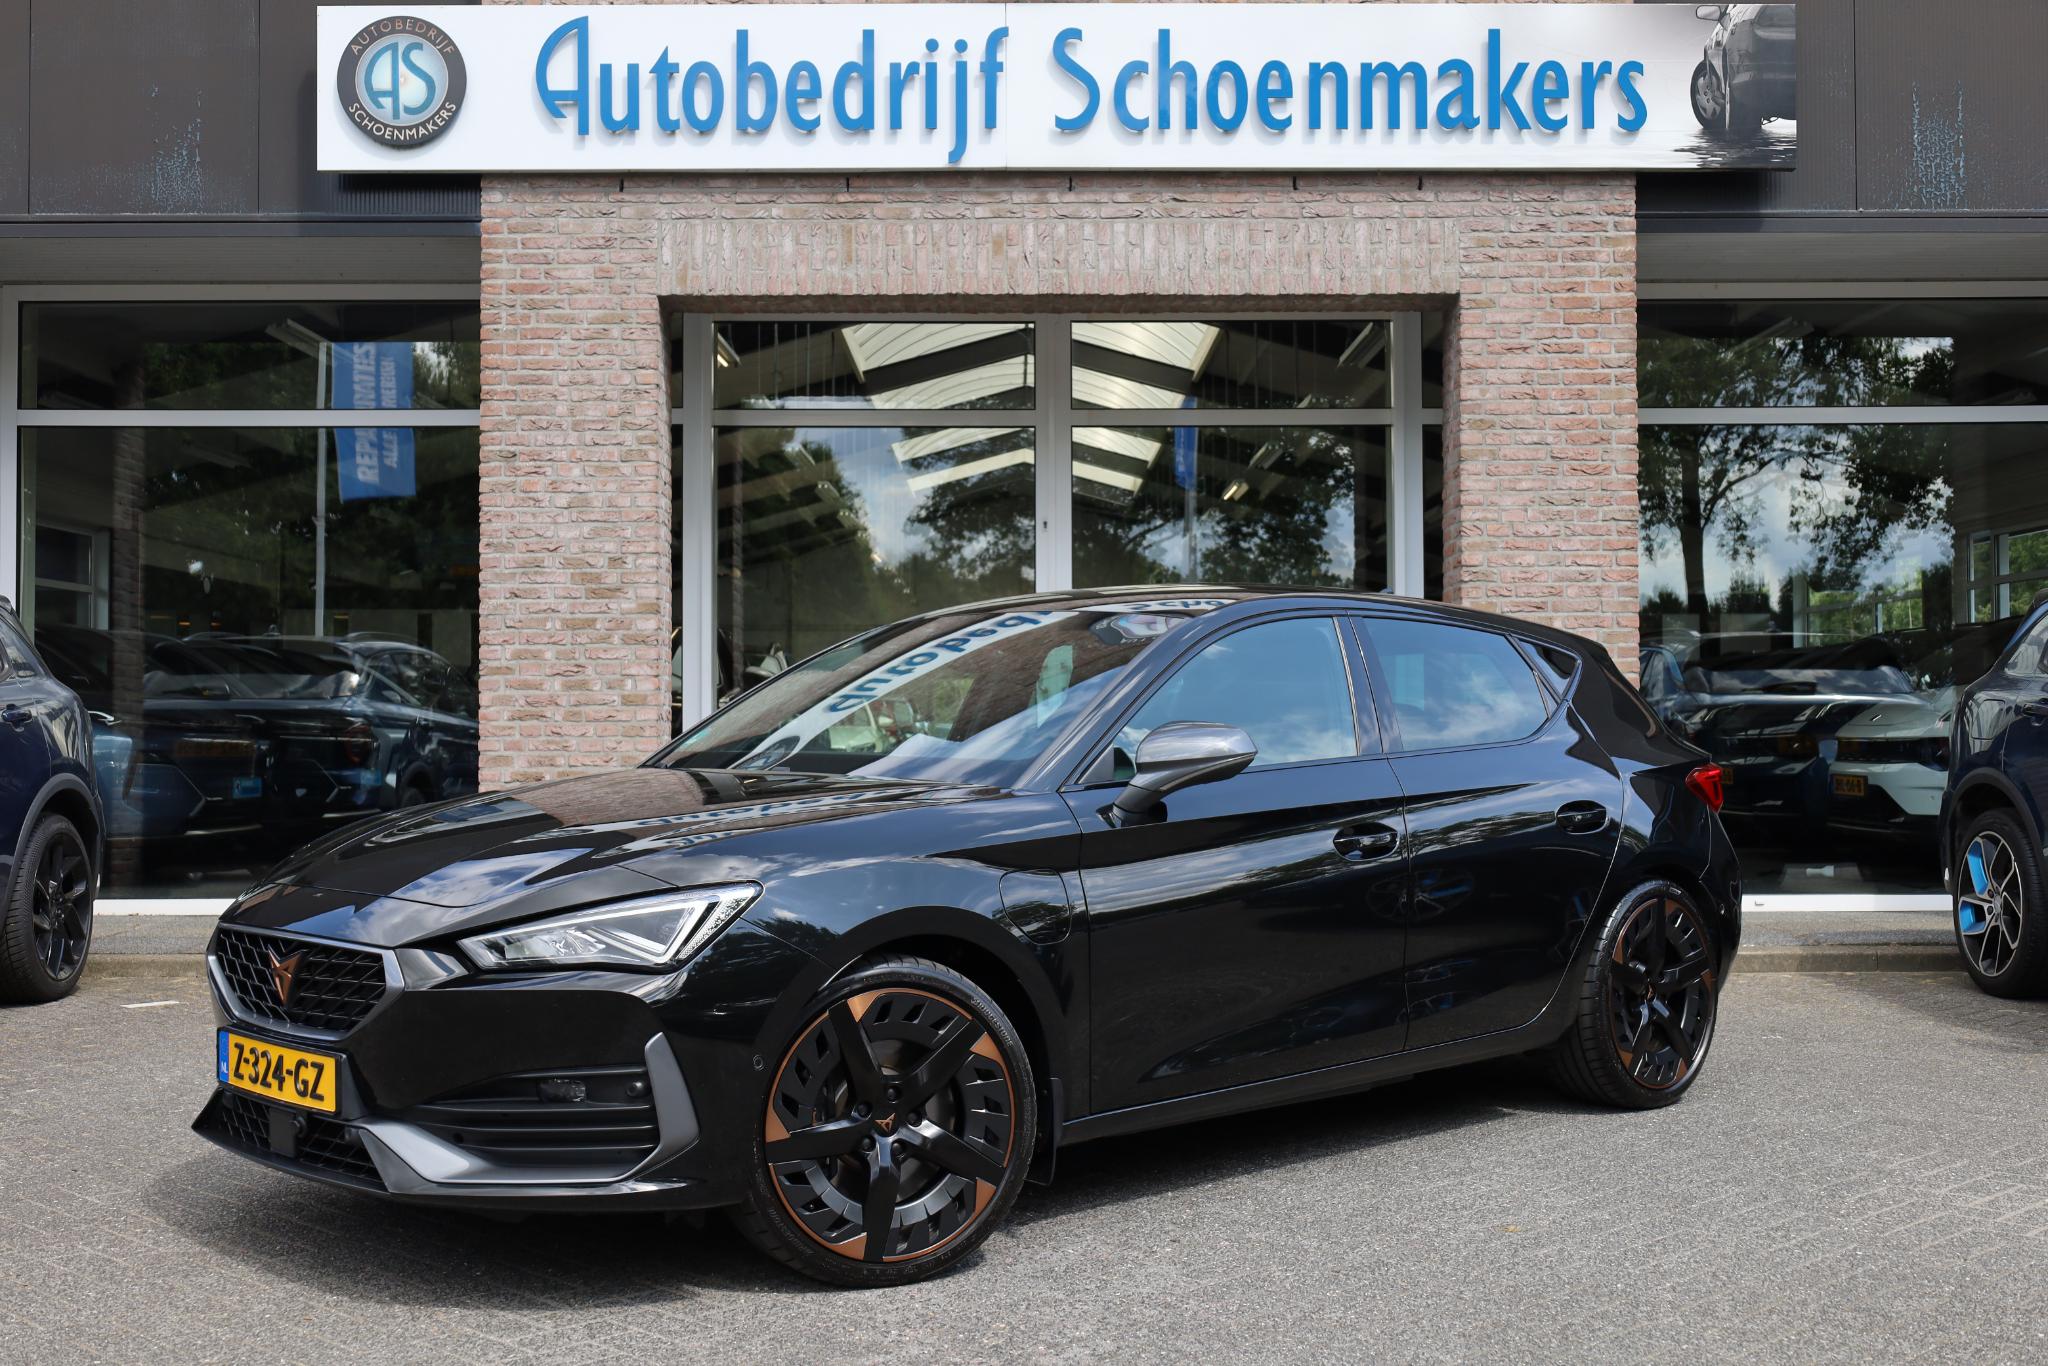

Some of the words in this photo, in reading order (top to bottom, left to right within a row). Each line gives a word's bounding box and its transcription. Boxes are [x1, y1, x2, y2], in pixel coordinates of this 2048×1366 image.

[350, 19, 455, 55] AUTOBEDRIJF
[364, 41, 436, 120] AS
[535, 15, 1009, 164] Autobedrijf
[1053, 27, 1648, 133] Schoenmakers
[348, 101, 456, 140] SCHOENMAKERS
[233, 1041, 325, 1102] Z-324-GZ
